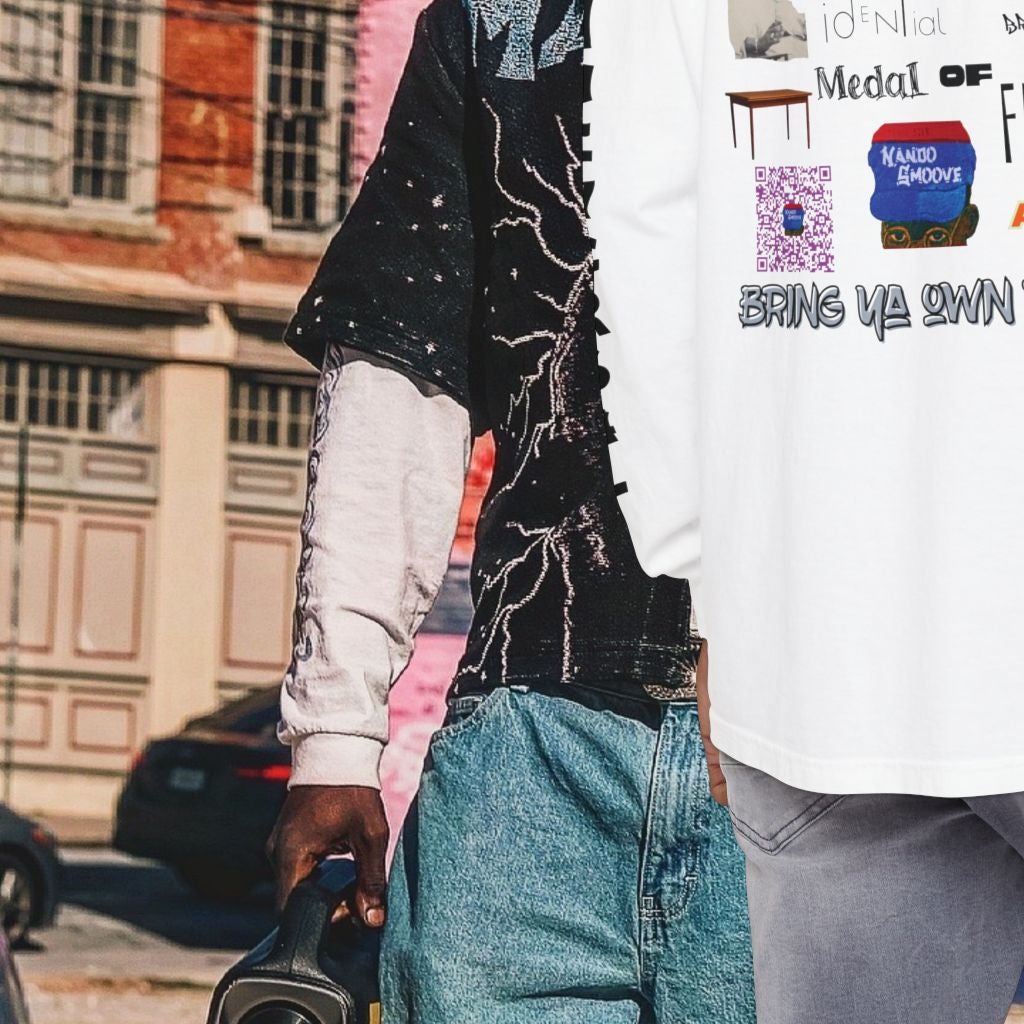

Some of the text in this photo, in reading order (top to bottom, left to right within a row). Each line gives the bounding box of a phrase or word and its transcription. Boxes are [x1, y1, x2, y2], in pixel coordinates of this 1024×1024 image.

[814, 61, 929, 101] Medal
[939, 63, 993, 88] OF
[896, 163, 962, 187] SMOOVE
[738, 281, 846, 331] BRING
[855, 284, 912, 343] YA
[921, 275, 1015, 326] OWN
